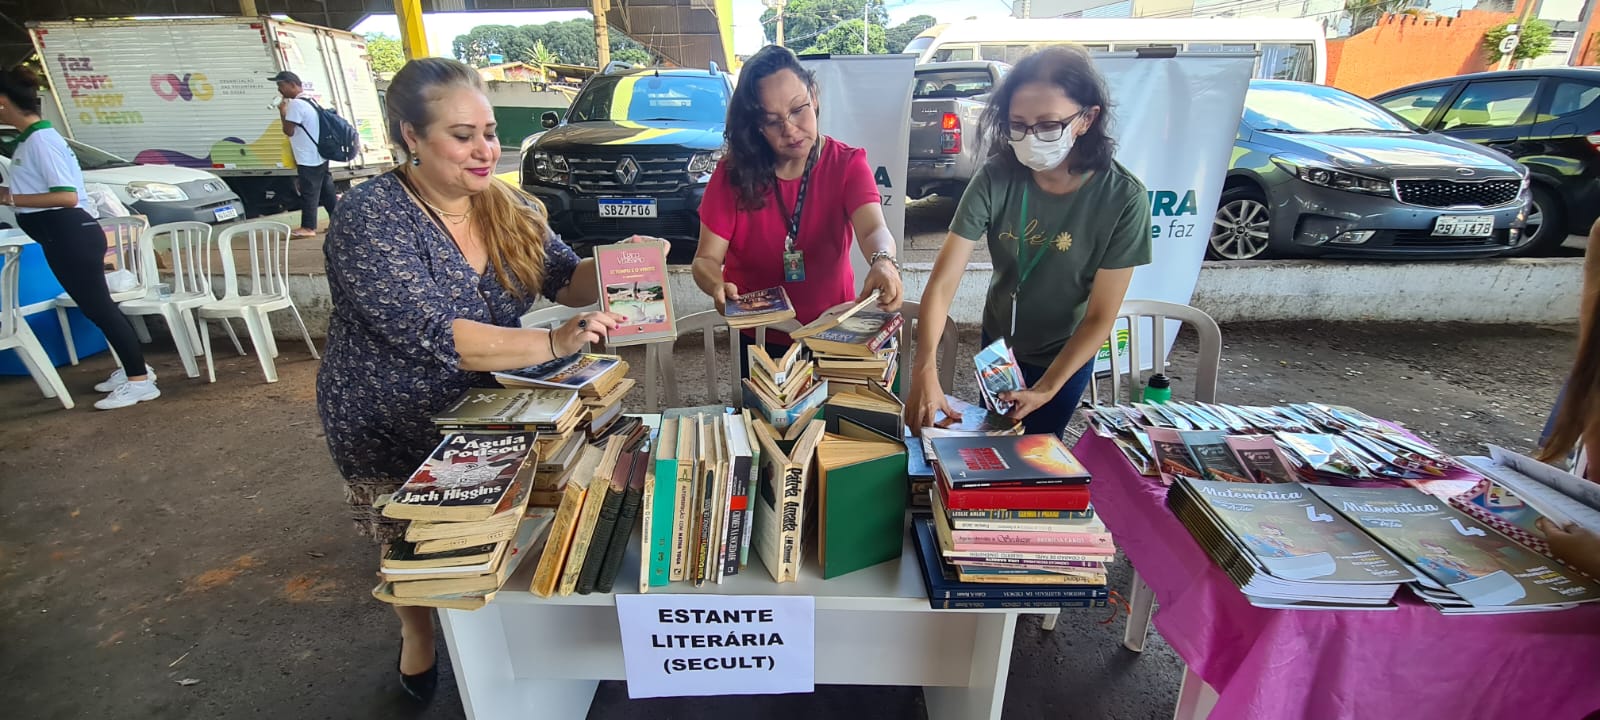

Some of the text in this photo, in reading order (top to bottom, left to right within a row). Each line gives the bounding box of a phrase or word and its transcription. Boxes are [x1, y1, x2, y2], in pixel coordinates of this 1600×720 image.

[1503, 38, 1513, 50] E
[57, 53, 94, 71] faz
[64, 72, 114, 91] bem
[150, 72, 215, 102] OVG
[70, 90, 124, 108] fazer
[79, 107, 144, 124] o bem
[604, 205, 651, 216] SBZ7F06
[1168, 219, 1195, 238] faz
[450, 435, 467, 445] A
[443, 444, 527, 459] Pousou
[785, 467, 802, 498] Pátria
[401, 490, 440, 503] Jack
[443, 485, 502, 501] Higgins
[782, 501, 799, 532] Amada
[1306, 505, 1335, 523] 4
[1450, 518, 1488, 537] 4
[658, 608, 774, 624] ESTANTE
[651, 631, 784, 648] LITERÁRIA
[663, 656, 775, 674] (SECULT)
